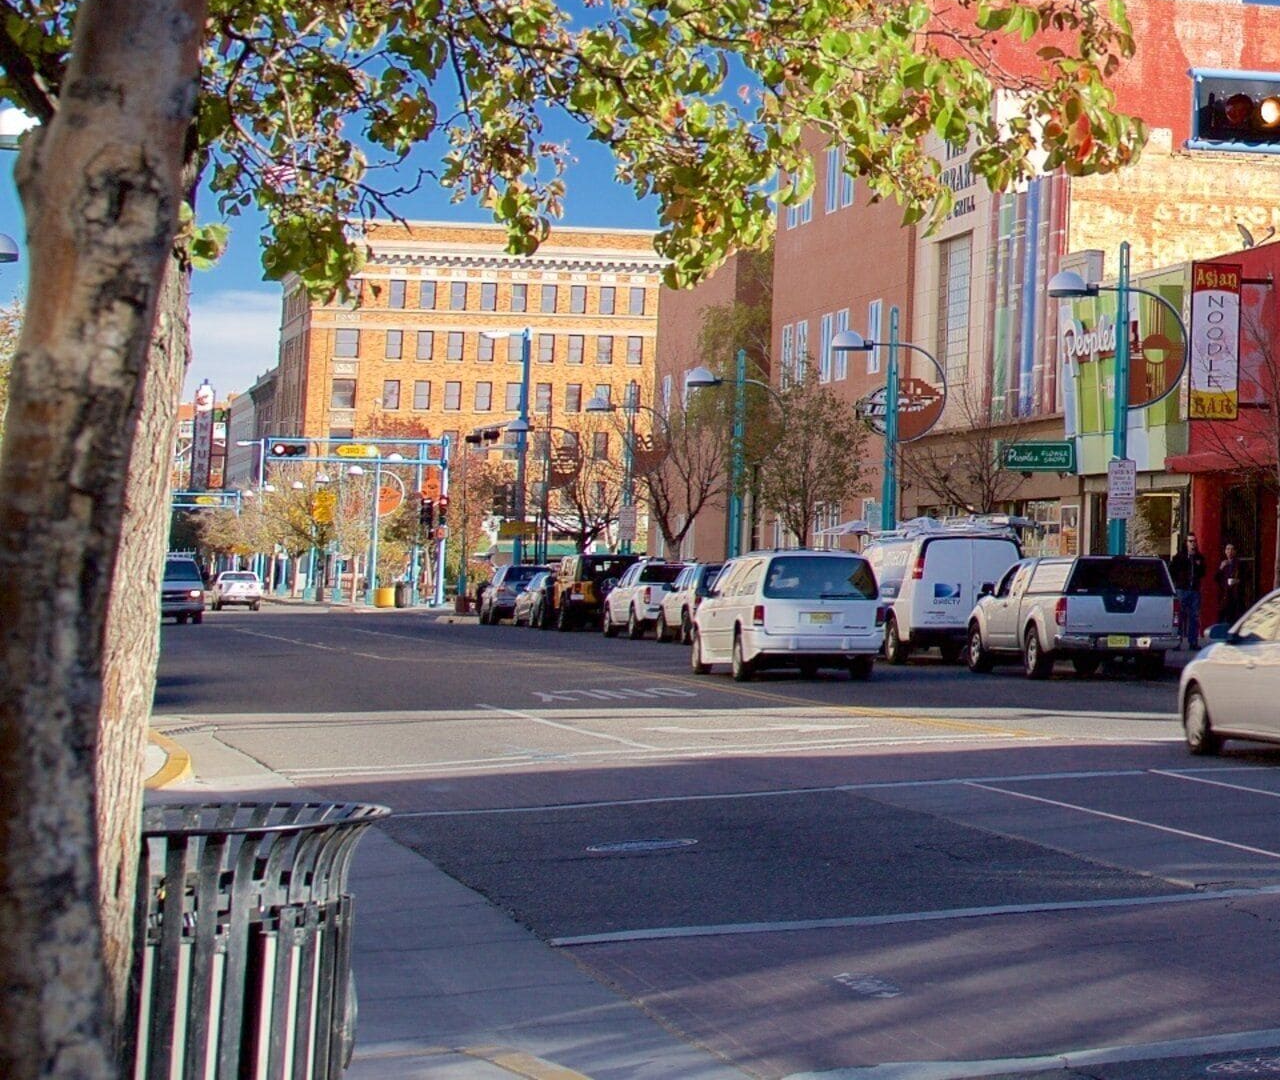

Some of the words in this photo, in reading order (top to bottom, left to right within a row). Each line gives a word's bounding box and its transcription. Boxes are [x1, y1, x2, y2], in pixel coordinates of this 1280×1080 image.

[1196, 269, 1237, 288] Asian
[1206, 295, 1225, 388] NOODLE
[1193, 396, 1233, 416] BAR
